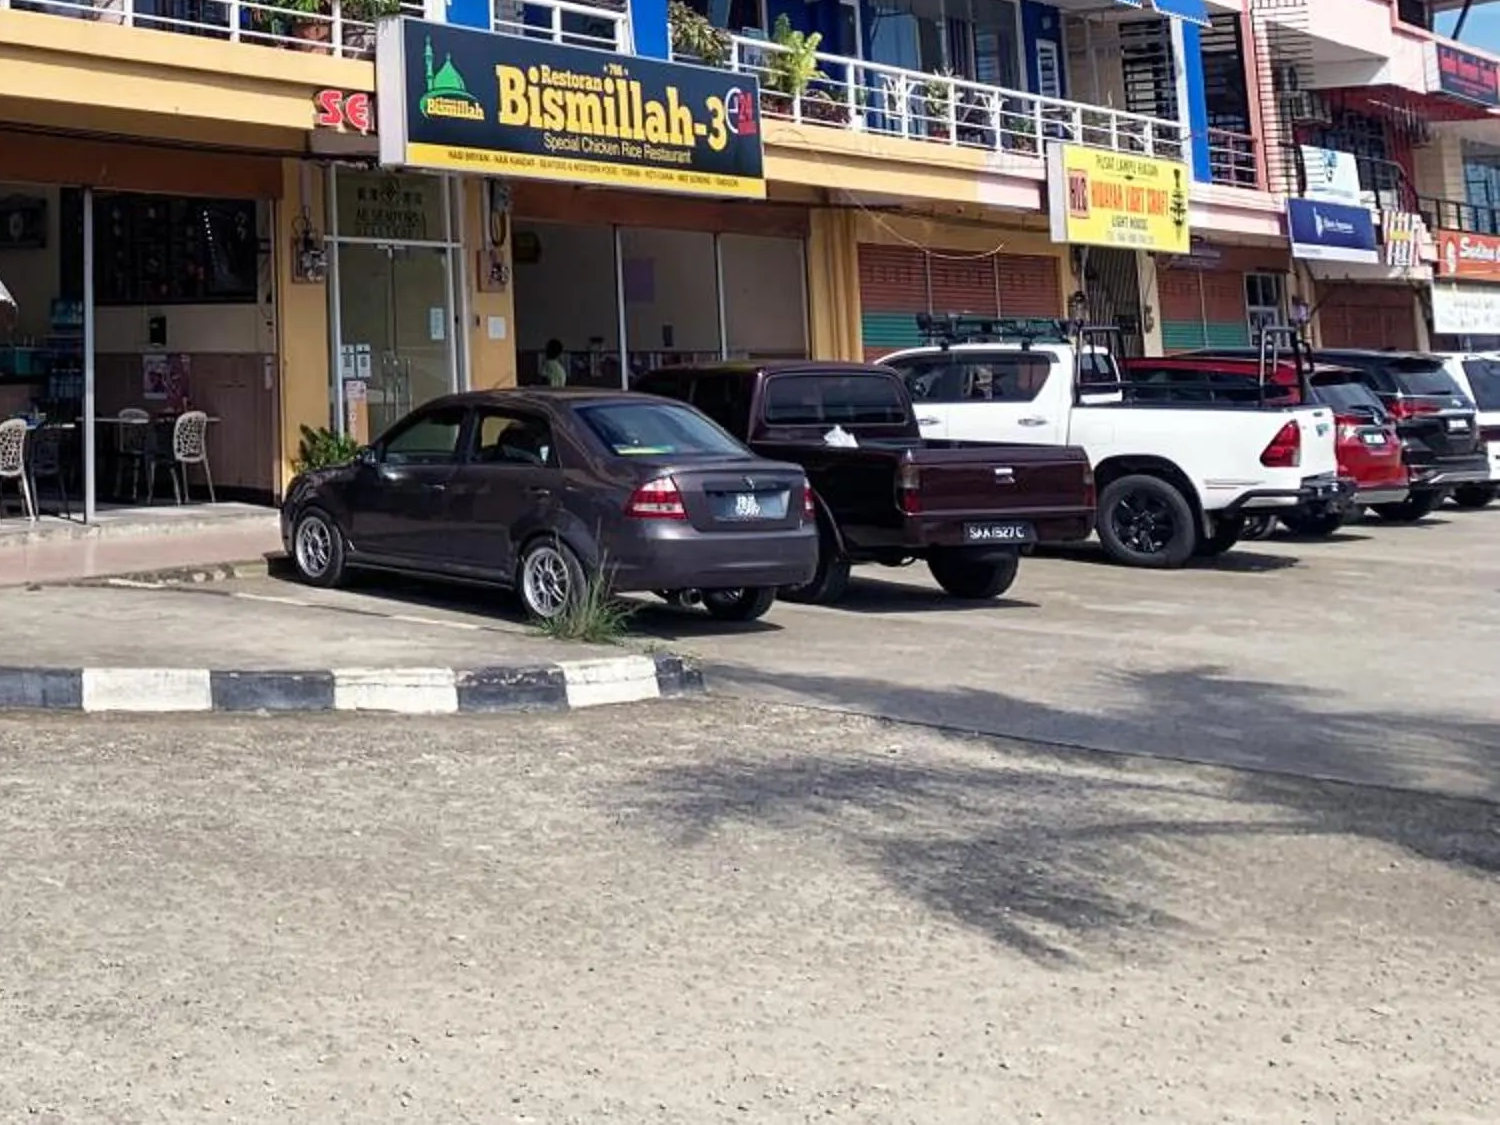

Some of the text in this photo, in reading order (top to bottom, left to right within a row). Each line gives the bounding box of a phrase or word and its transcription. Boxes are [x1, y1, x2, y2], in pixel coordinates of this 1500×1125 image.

[541, 64, 603, 92] Restoran
[318, 89, 375, 131] SE
[426, 97, 485, 120] Bismillah
[496, 64, 728, 152] Bismillah-3
[544, 132, 692, 163] Special Chicken Rice Restaurant
